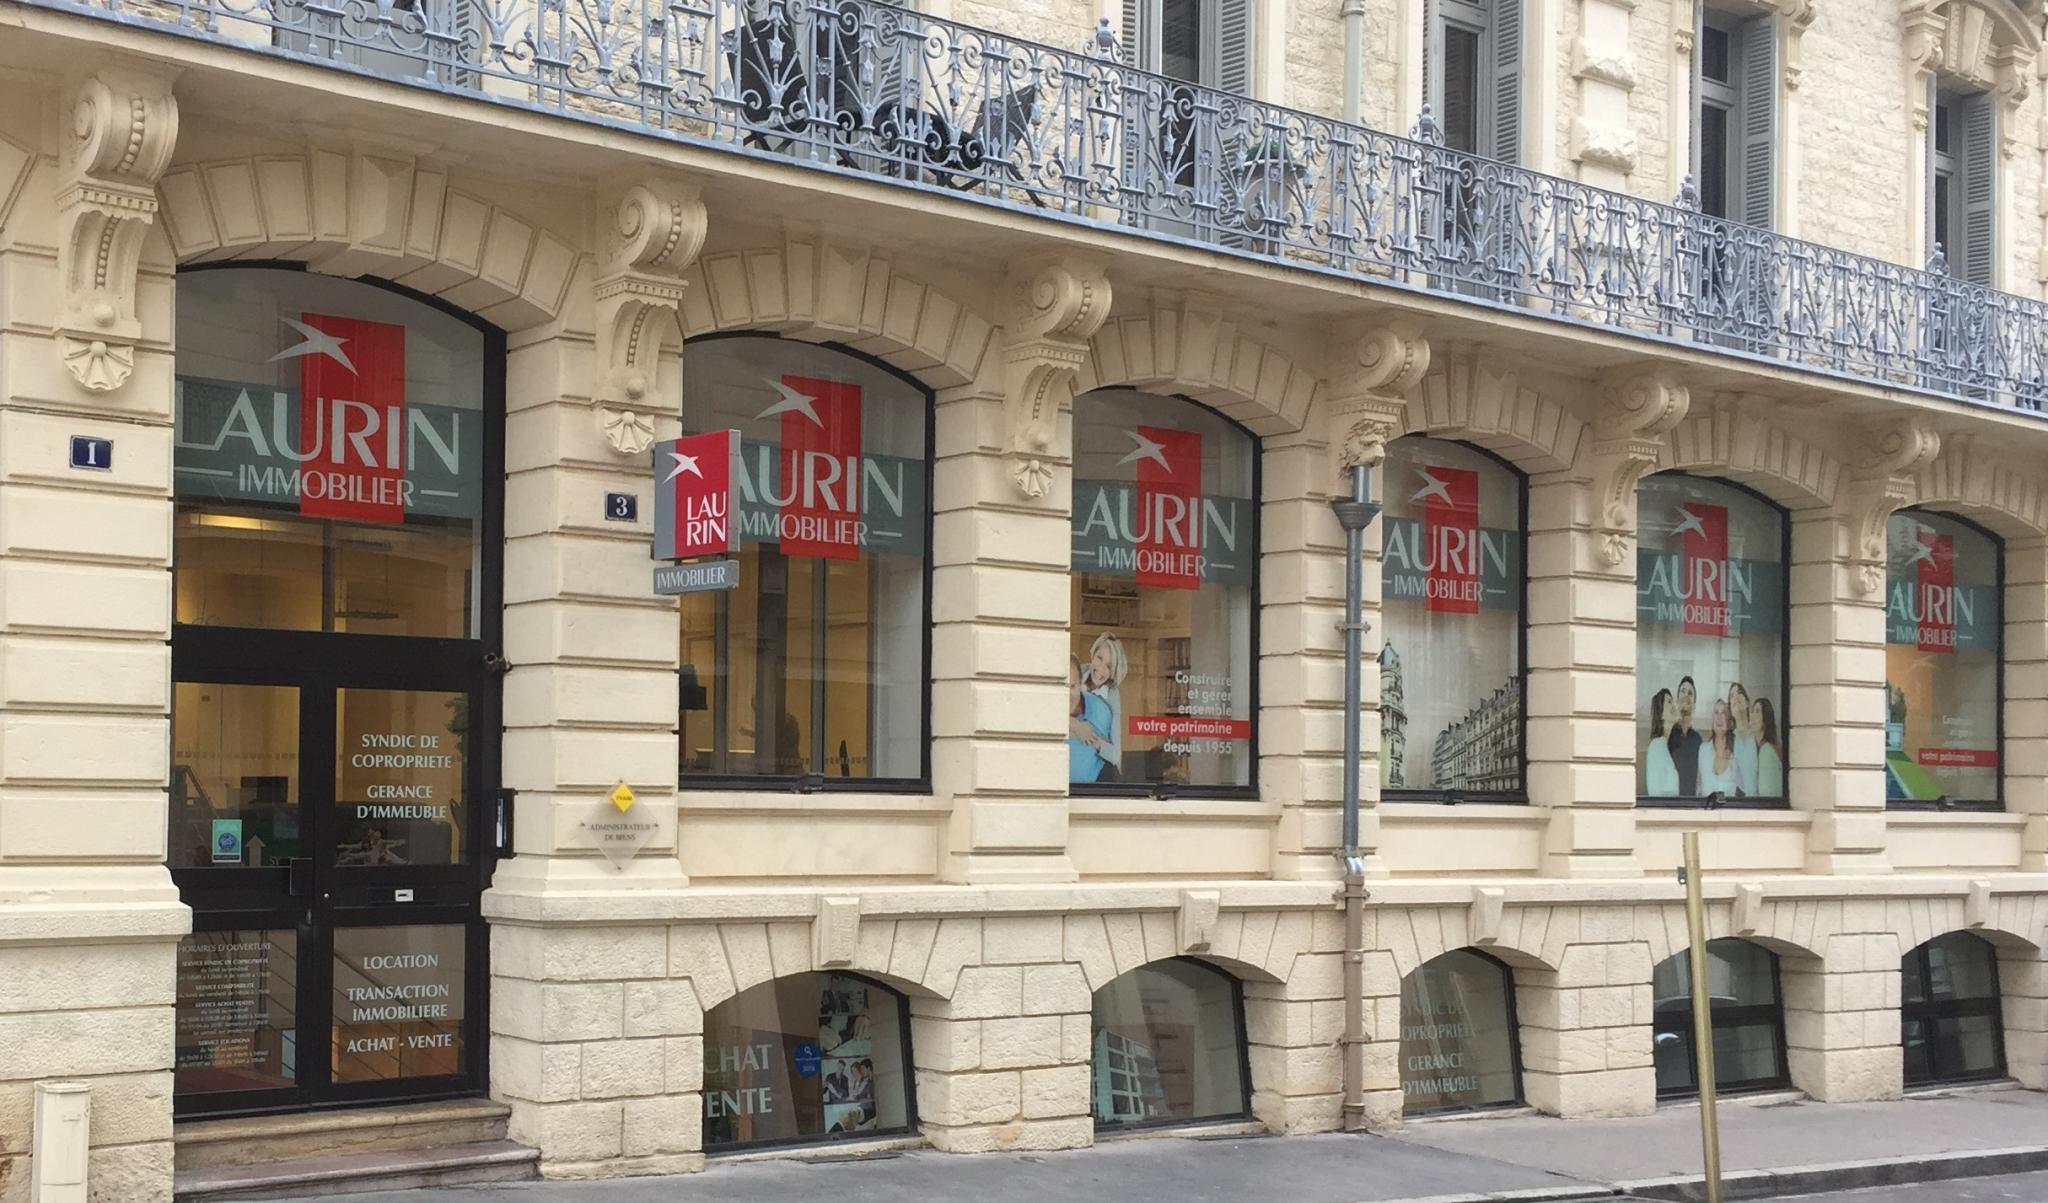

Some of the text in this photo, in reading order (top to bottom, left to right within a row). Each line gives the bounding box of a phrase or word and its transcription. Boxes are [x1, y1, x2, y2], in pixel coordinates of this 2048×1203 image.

[87, 441, 97, 465] 1
[239, 464, 414, 506] IMMOBILIER
[616, 496, 628, 516] 3
[687, 491, 727, 520] LAU
[1072, 486, 1236, 551] AURIN
[686, 517, 727, 546] RIN
[1382, 521, 1507, 579] AURIN
[1098, 546, 1207, 578] IMMOBILIER
[657, 566, 726, 589] IMMOBILIER
[1638, 554, 1753, 605] AURIN
[1394, 574, 1484, 602] IMMOBILIER
[1887, 581, 1974, 627] AURIN
[1658, 603, 1733, 627] IMMOBILIER
[1896, 625, 1957, 649] IMMOBILIER
[1175, 671, 1233, 687] Construire
[1187, 688, 1200, 700] et
[1178, 703, 1233, 716] ensemble
[1137, 720, 1232, 735] votre patrimoine
[361, 733, 439, 749] SYNDIC DE
[1163, 739, 1232, 755] depuis 1955
[352, 754, 452, 768] COPROPRIETE
[367, 785, 433, 799] GERANCE
[357, 804, 447, 819] D'IMMEUBLE
[591, 823, 651, 832] ADMINISTRATEUR
[363, 954, 439, 970] LOCATION
[346, 984, 449, 1001] TRANSACTION
[353, 1004, 448, 1021] IMMOBILIERE
[346, 1036, 396, 1053] ACHAT
[408, 1033, 453, 1049] VENTE
[1408, 1053, 1465, 1072] GERANCE
[1402, 1075, 1479, 1097] D'IMMEUBLE
[704, 1087, 773, 1118] ENTE
